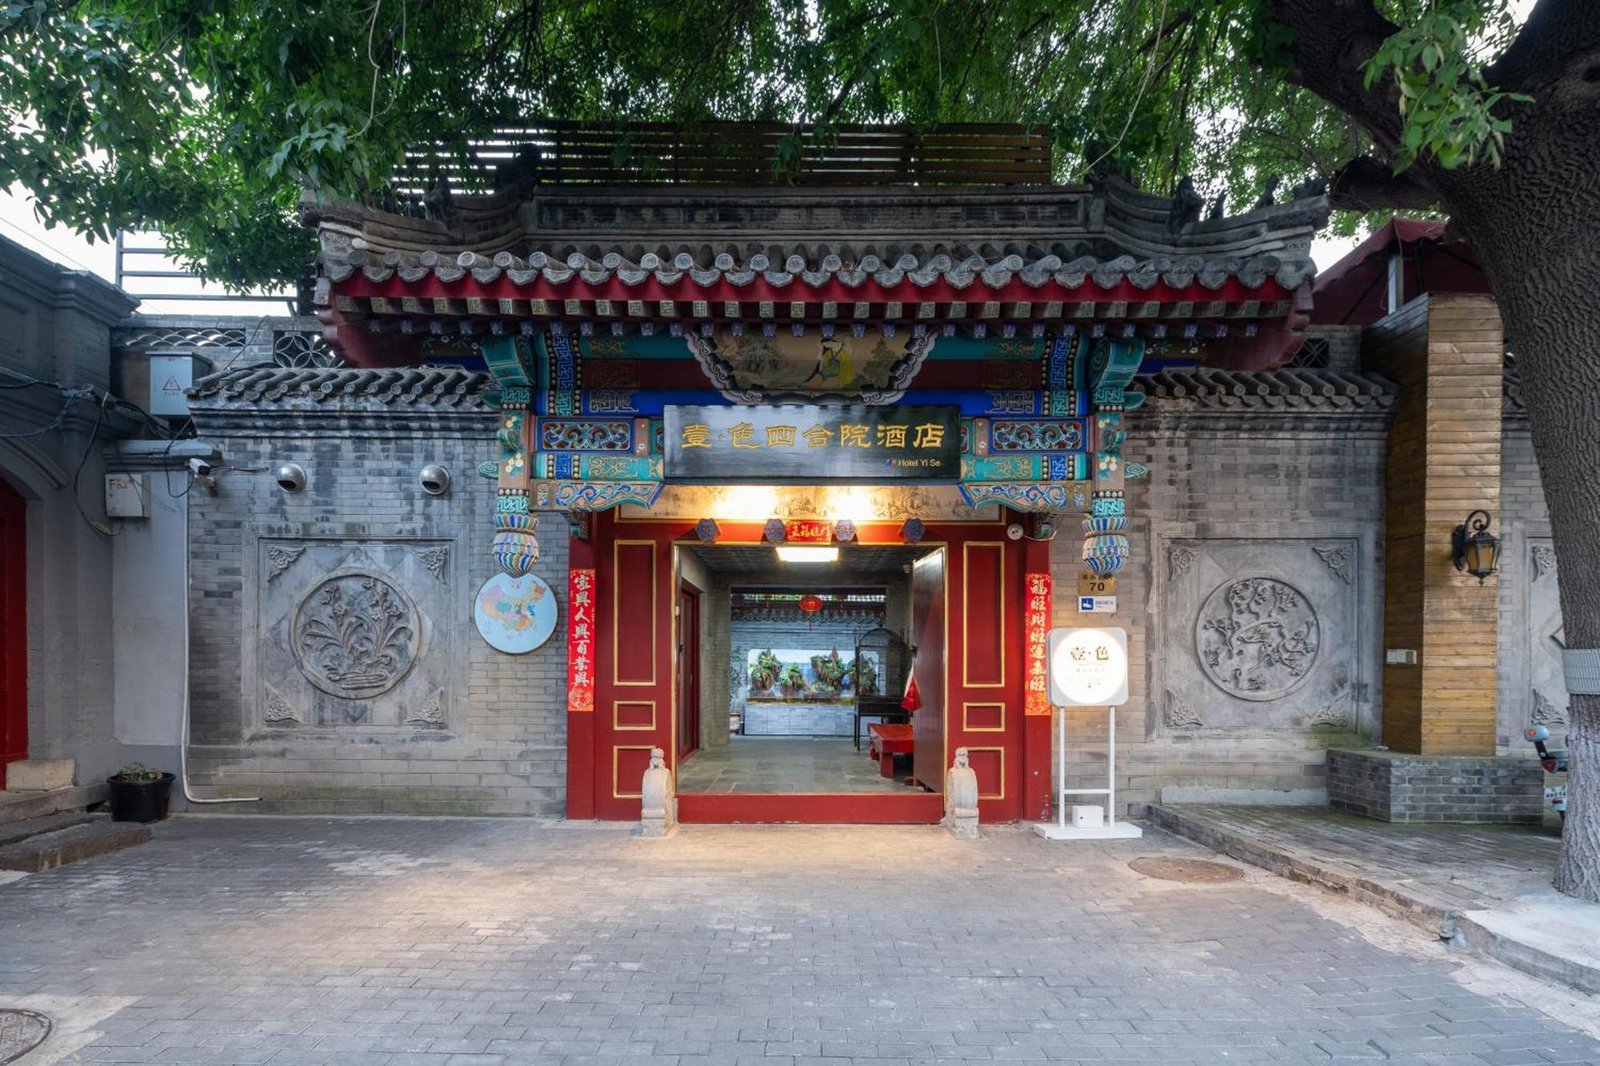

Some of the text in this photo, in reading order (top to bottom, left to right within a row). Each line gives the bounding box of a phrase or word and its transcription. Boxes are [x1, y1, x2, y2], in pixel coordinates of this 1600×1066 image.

[898, 459, 941, 467] Hotel Yi Se
[1089, 582, 1105, 591] 70
